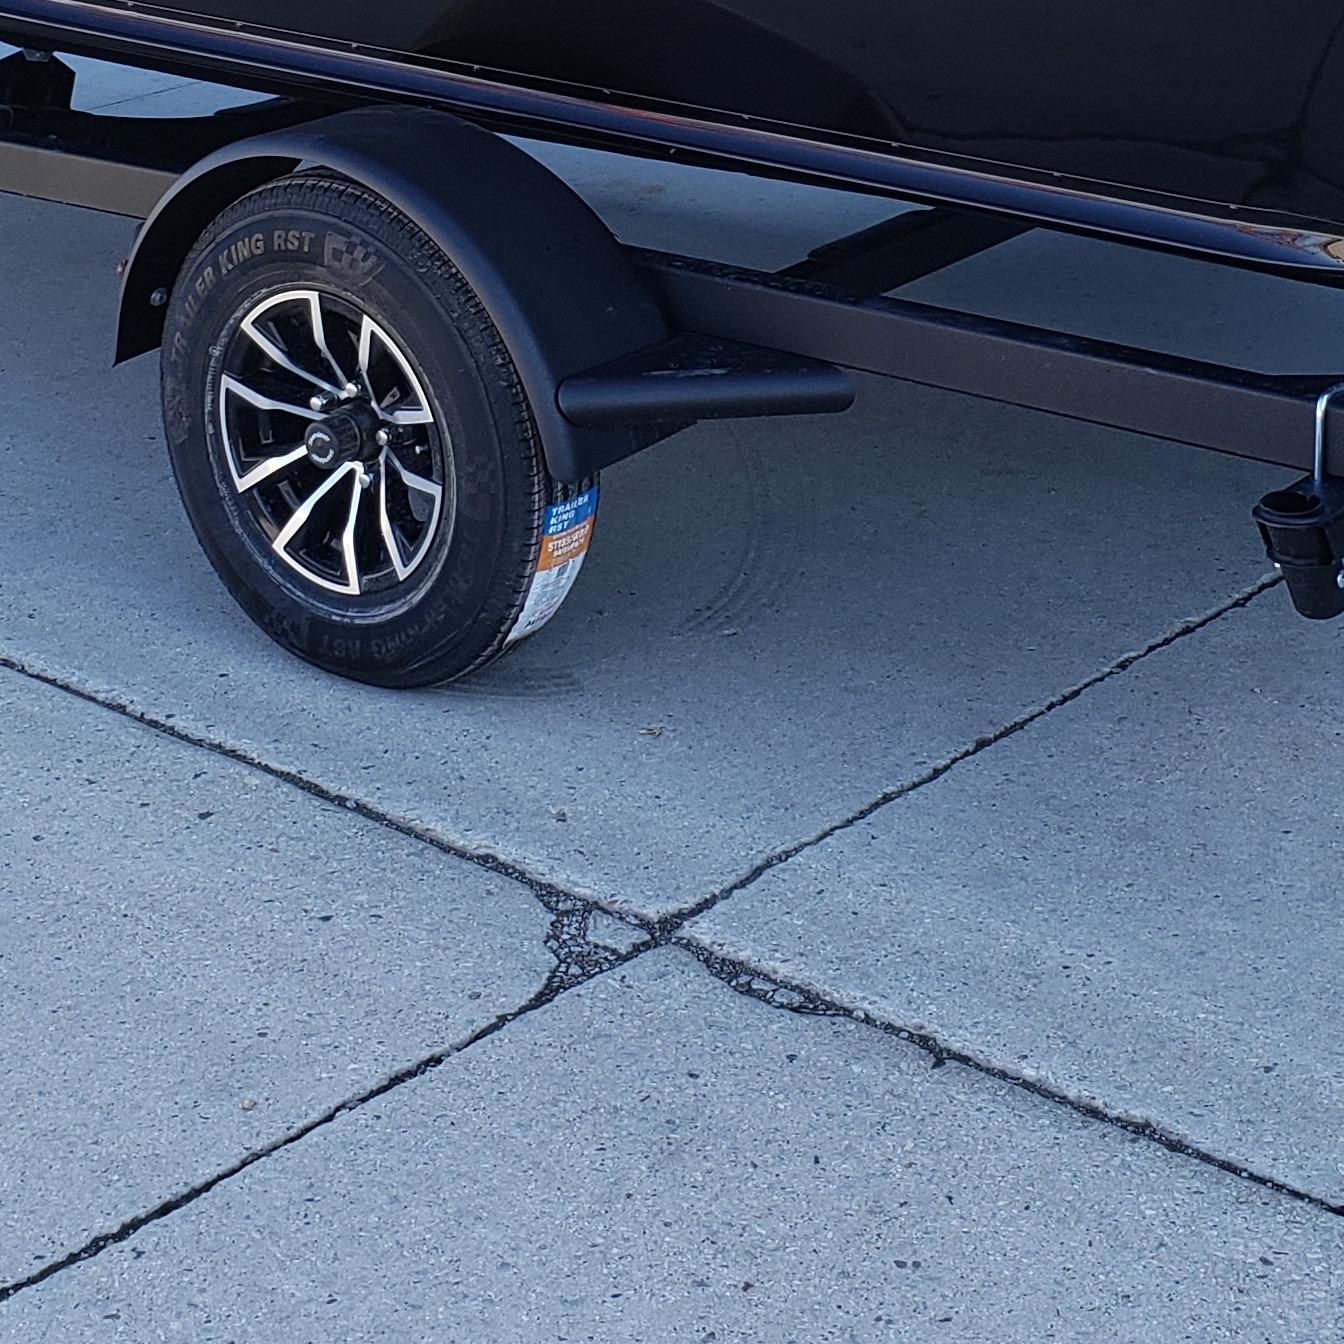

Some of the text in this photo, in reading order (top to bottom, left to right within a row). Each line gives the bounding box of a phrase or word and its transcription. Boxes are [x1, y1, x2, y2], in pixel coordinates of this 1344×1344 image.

[218, 232, 265, 276] KING
[273, 229, 315, 254] RST
[549, 509, 575, 525] KING
[551, 493, 589, 517] TRAILER
